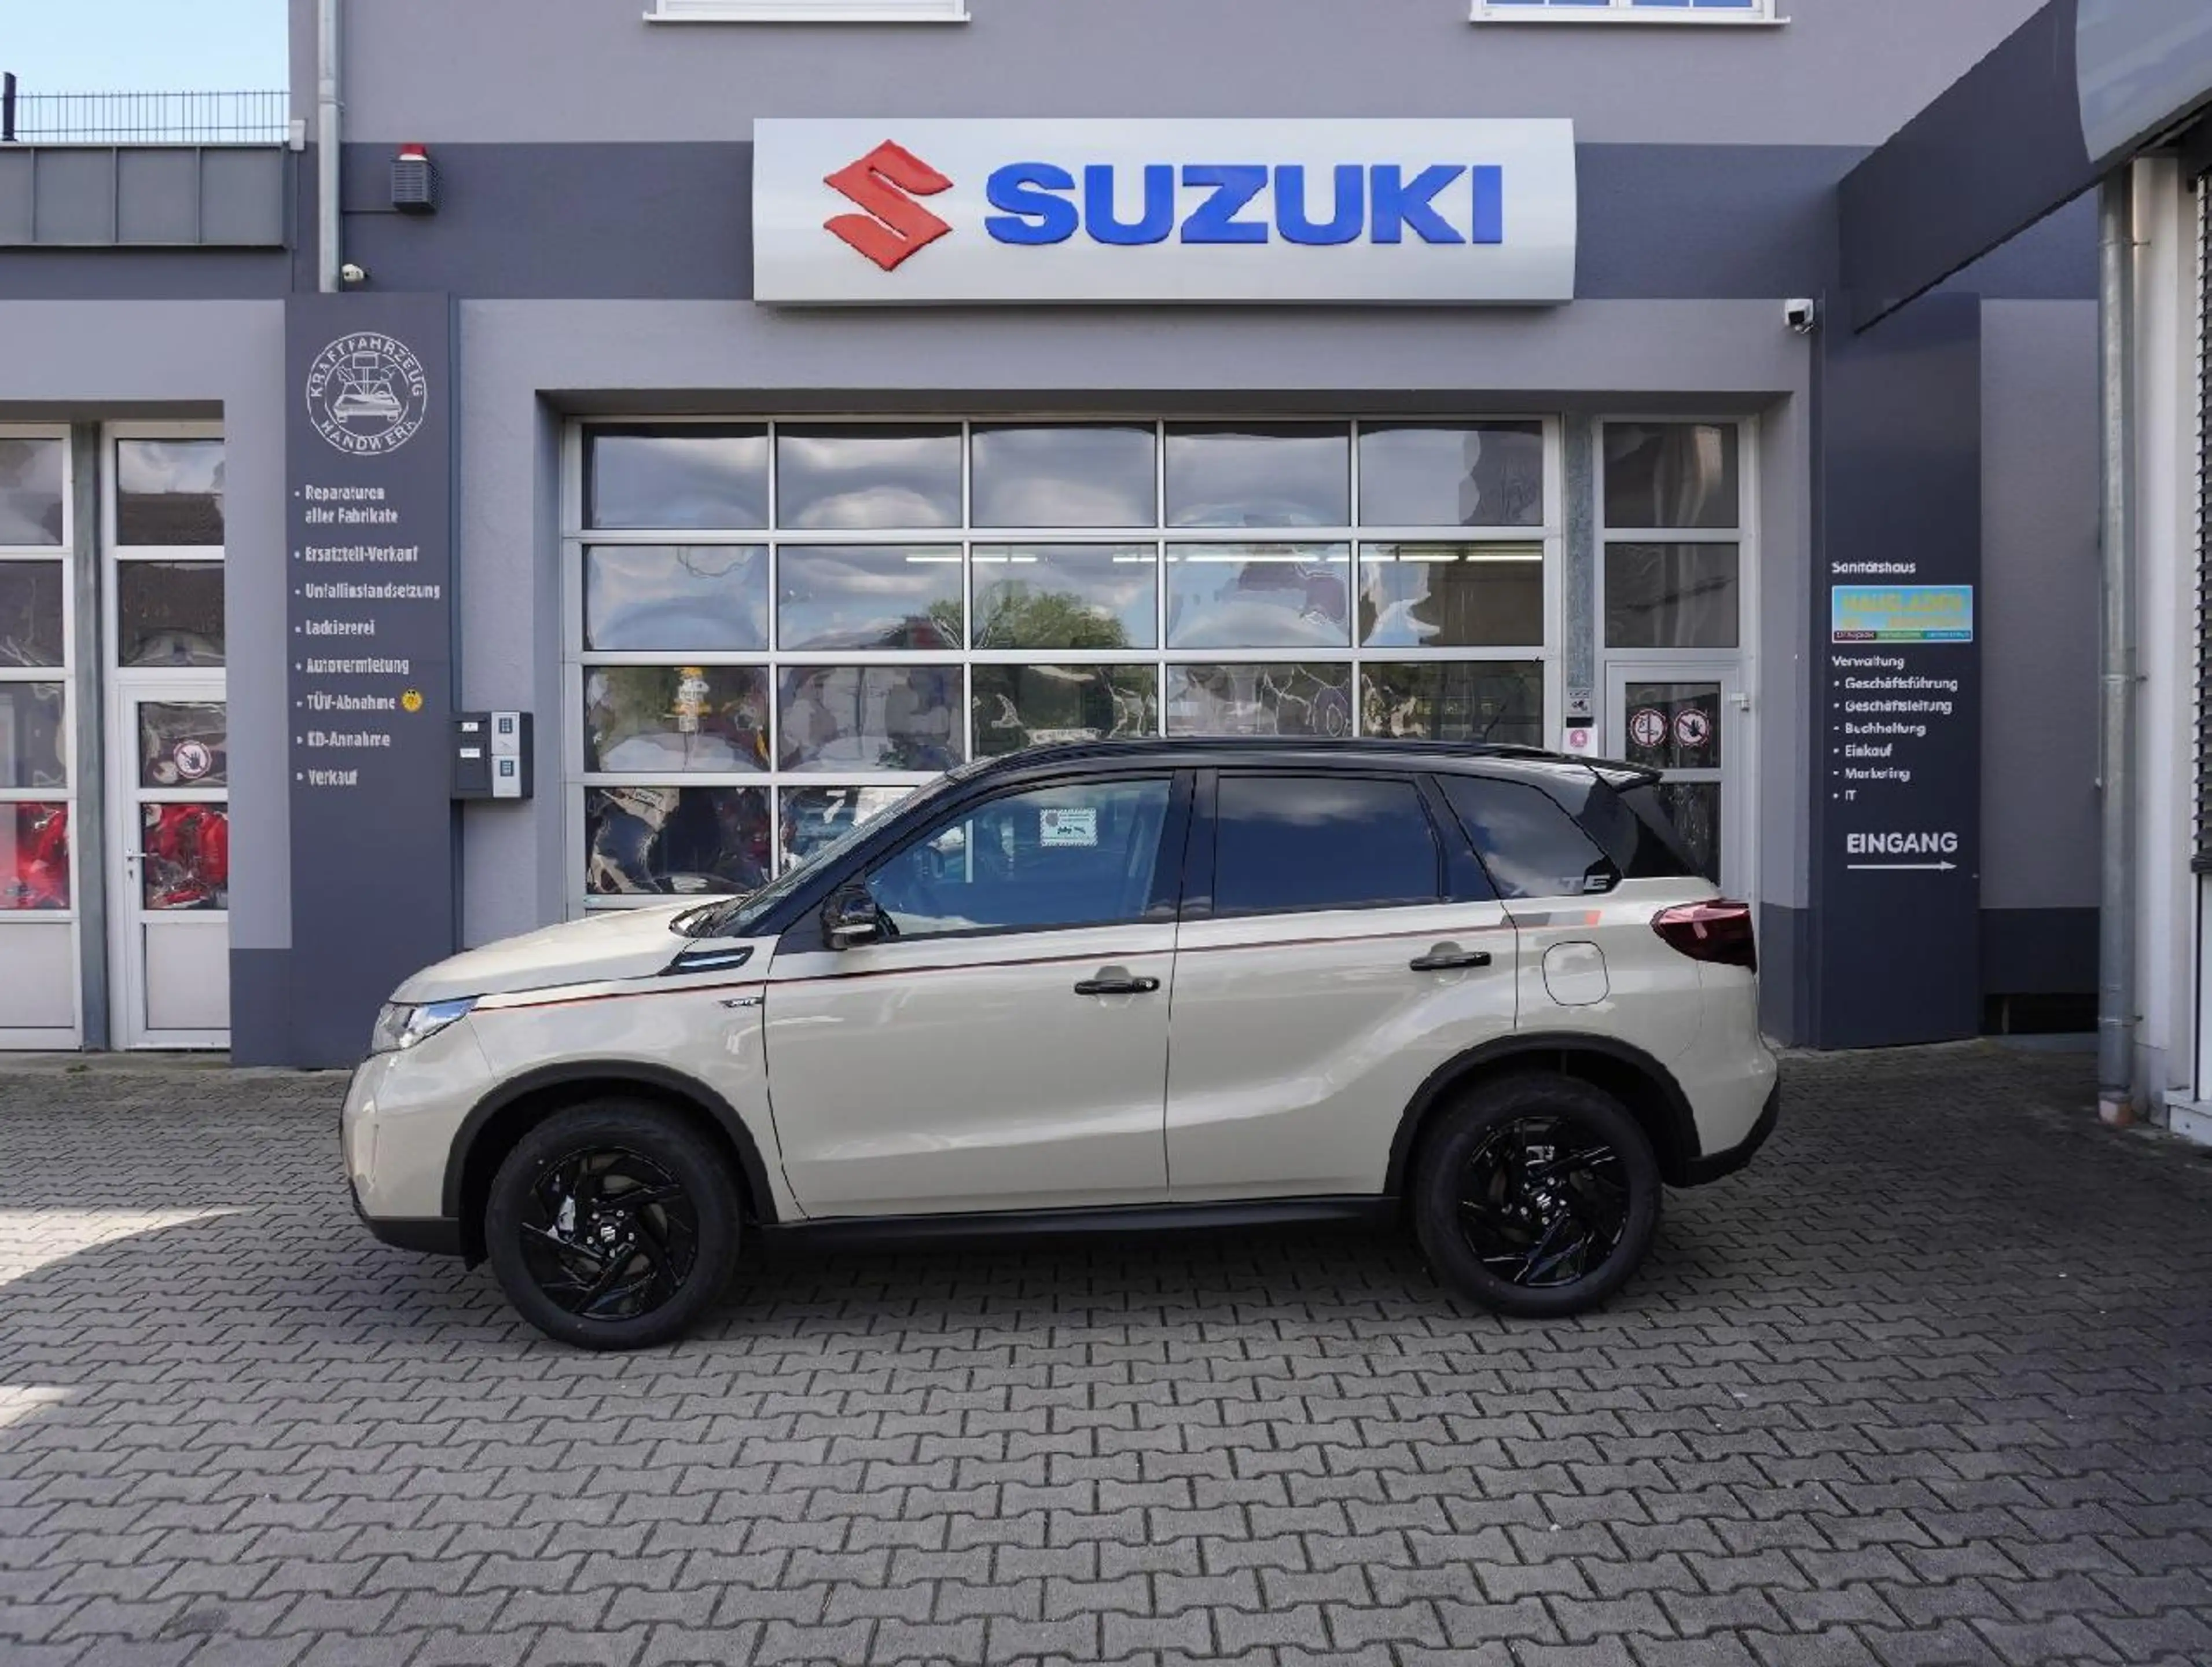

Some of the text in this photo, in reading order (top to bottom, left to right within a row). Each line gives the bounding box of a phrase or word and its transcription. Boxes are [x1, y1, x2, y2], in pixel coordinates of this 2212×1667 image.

[984, 162, 1502, 245] SUZUKI
[311, 337, 423, 397] KRAFTFAHRZEUG
[320, 420, 416, 450] HANDWERK
[305, 485, 385, 501] Reparaturen
[306, 508, 398, 523] aller Fabrikate
[306, 546, 418, 562] Ersatzteil-Verkauf
[1831, 561, 1916, 574] Sanitätshaus
[306, 583, 440, 599] Unfallinstandsetzung
[306, 619, 375, 635] Lackiererei
[306, 658, 410, 674] Autovermietung
[1831, 655, 1905, 670] Verwaltung
[1845, 677, 1959, 692] Geschäftsführung
[307, 691, 396, 710] TÜV-Abnahme
[1845, 699, 1953, 714] Geschäftsleitung
[1845, 722, 1927, 737] Buchhaltung
[307, 730, 391, 747] KD-Annahme
[1845, 743, 1893, 757] Einkauf
[308, 769, 358, 785] Verkauf
[1845, 768, 1911, 782] Marketing
[1845, 790, 1857, 801] IT
[1847, 832, 1959, 854] EINGANG
